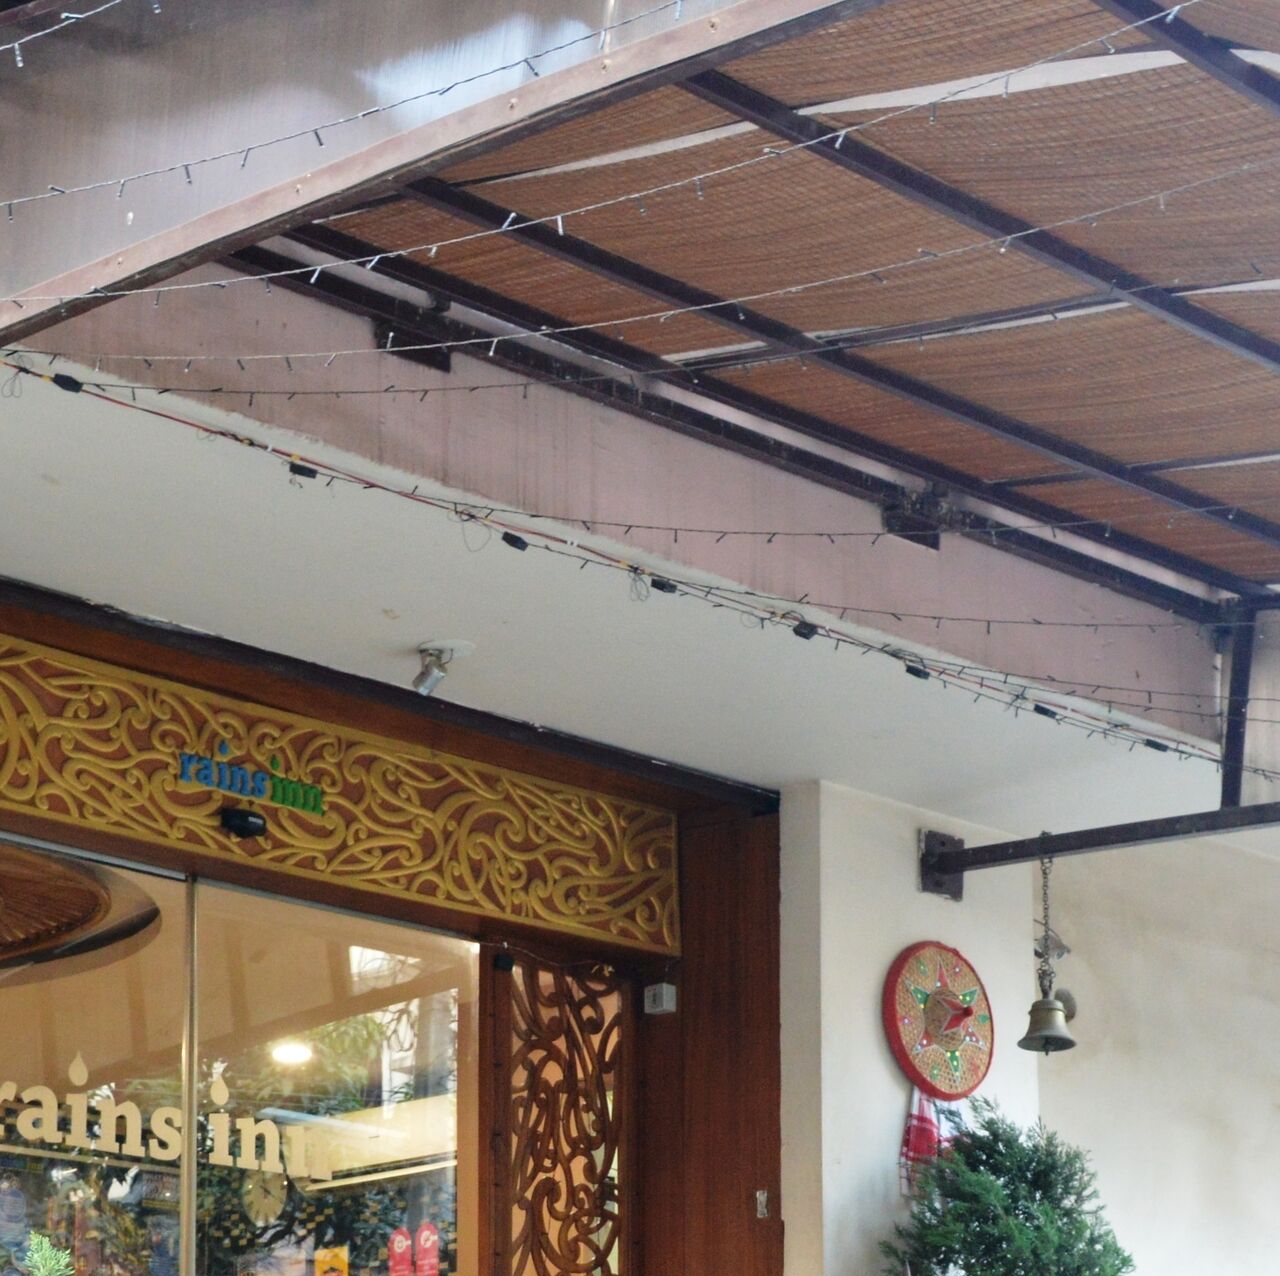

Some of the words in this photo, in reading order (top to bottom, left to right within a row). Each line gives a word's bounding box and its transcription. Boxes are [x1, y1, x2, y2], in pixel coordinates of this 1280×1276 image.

[179, 741, 269, 798] rains
[270, 755, 324, 816] inn
[208, 1074, 333, 1181] inn
